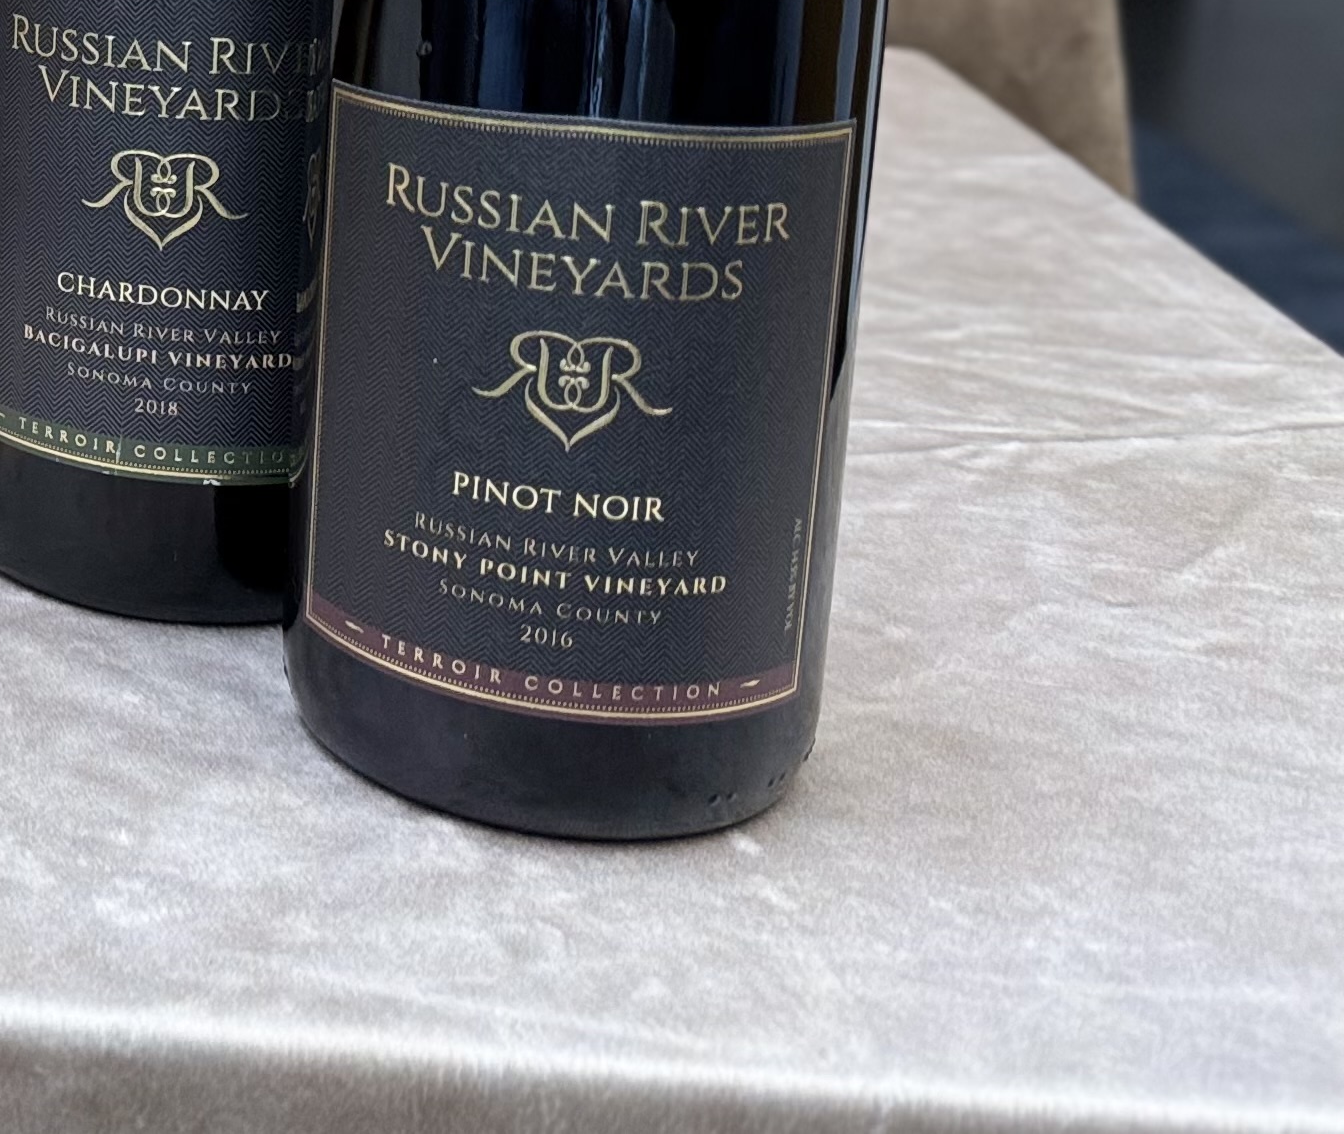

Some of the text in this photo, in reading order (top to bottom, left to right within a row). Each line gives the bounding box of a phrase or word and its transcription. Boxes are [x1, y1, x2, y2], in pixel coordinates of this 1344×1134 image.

[12, 12, 306, 75] RUSSIAN RIV
[38, 64, 292, 122] VINEYARD
[386, 162, 790, 247] RUSSIAN RIVER
[420, 224, 743, 301] VINEYARDS
[57, 271, 269, 312] CHARDONNAY
[24, 324, 292, 369] BACIGALUPI VINEYARD
[45, 306, 282, 345] RUSSIAN RIVER VALLEY
[67, 362, 252, 394] SONOMA COUNTY
[134, 398, 179, 416] 2018
[18, 417, 292, 465] TERROIR COLLECTIO
[453, 471, 665, 522] PINOT NOIR
[383, 529, 727, 596] STONY POINT VINEYARD
[414, 511, 699, 568] RUSSIAN RIVER VALLEY
[438, 578, 662, 626] SONOMA COUNTY
[519, 623, 573, 649] 2016
[381, 633, 721, 702] TERROIR COLLECTION
